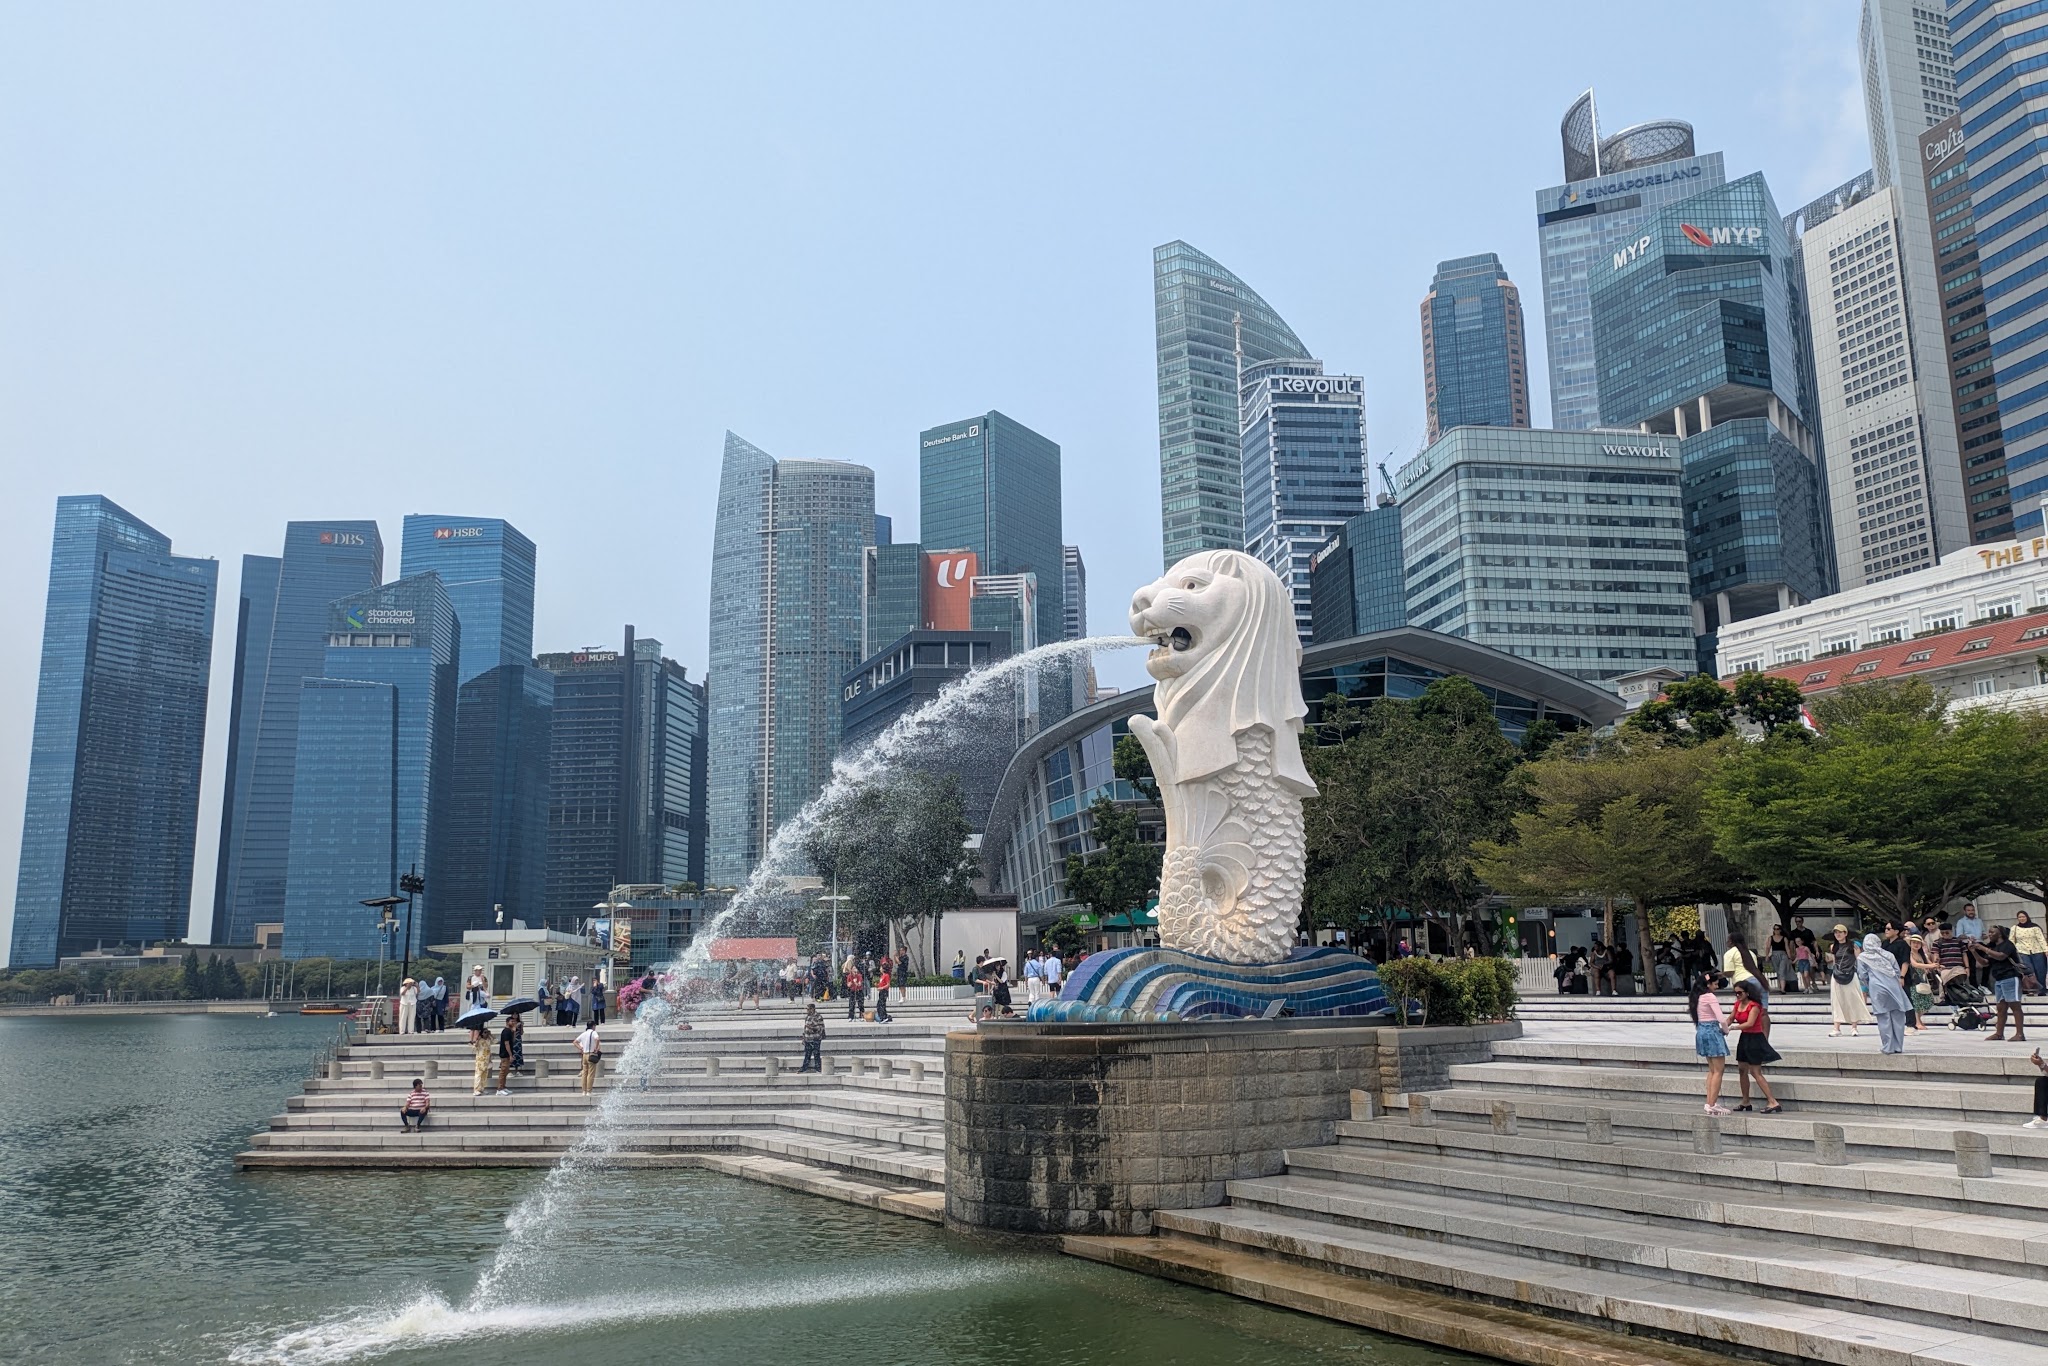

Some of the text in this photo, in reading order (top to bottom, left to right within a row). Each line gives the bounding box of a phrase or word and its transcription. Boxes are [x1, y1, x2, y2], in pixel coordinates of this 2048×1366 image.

[1585, 165, 1701, 199] SINGAPORELAND
[1712, 227, 1762, 244] MYP
[1613, 235, 1651, 270] MYP
[1210, 280, 1235, 293] Keppel
[1279, 378, 1355, 394] Revolut
[923, 432, 968, 448] Deutsche Bank
[1602, 441, 1672, 458] wework
[334, 533, 364, 545] DBS
[453, 527, 483, 537] HSBC
[1980, 537, 2048, 570] THE F
[367, 608, 413, 617] standard
[367, 616, 416, 624] chartered
[588, 653, 615, 662] MUFG
[844, 679, 862, 702] OUE
